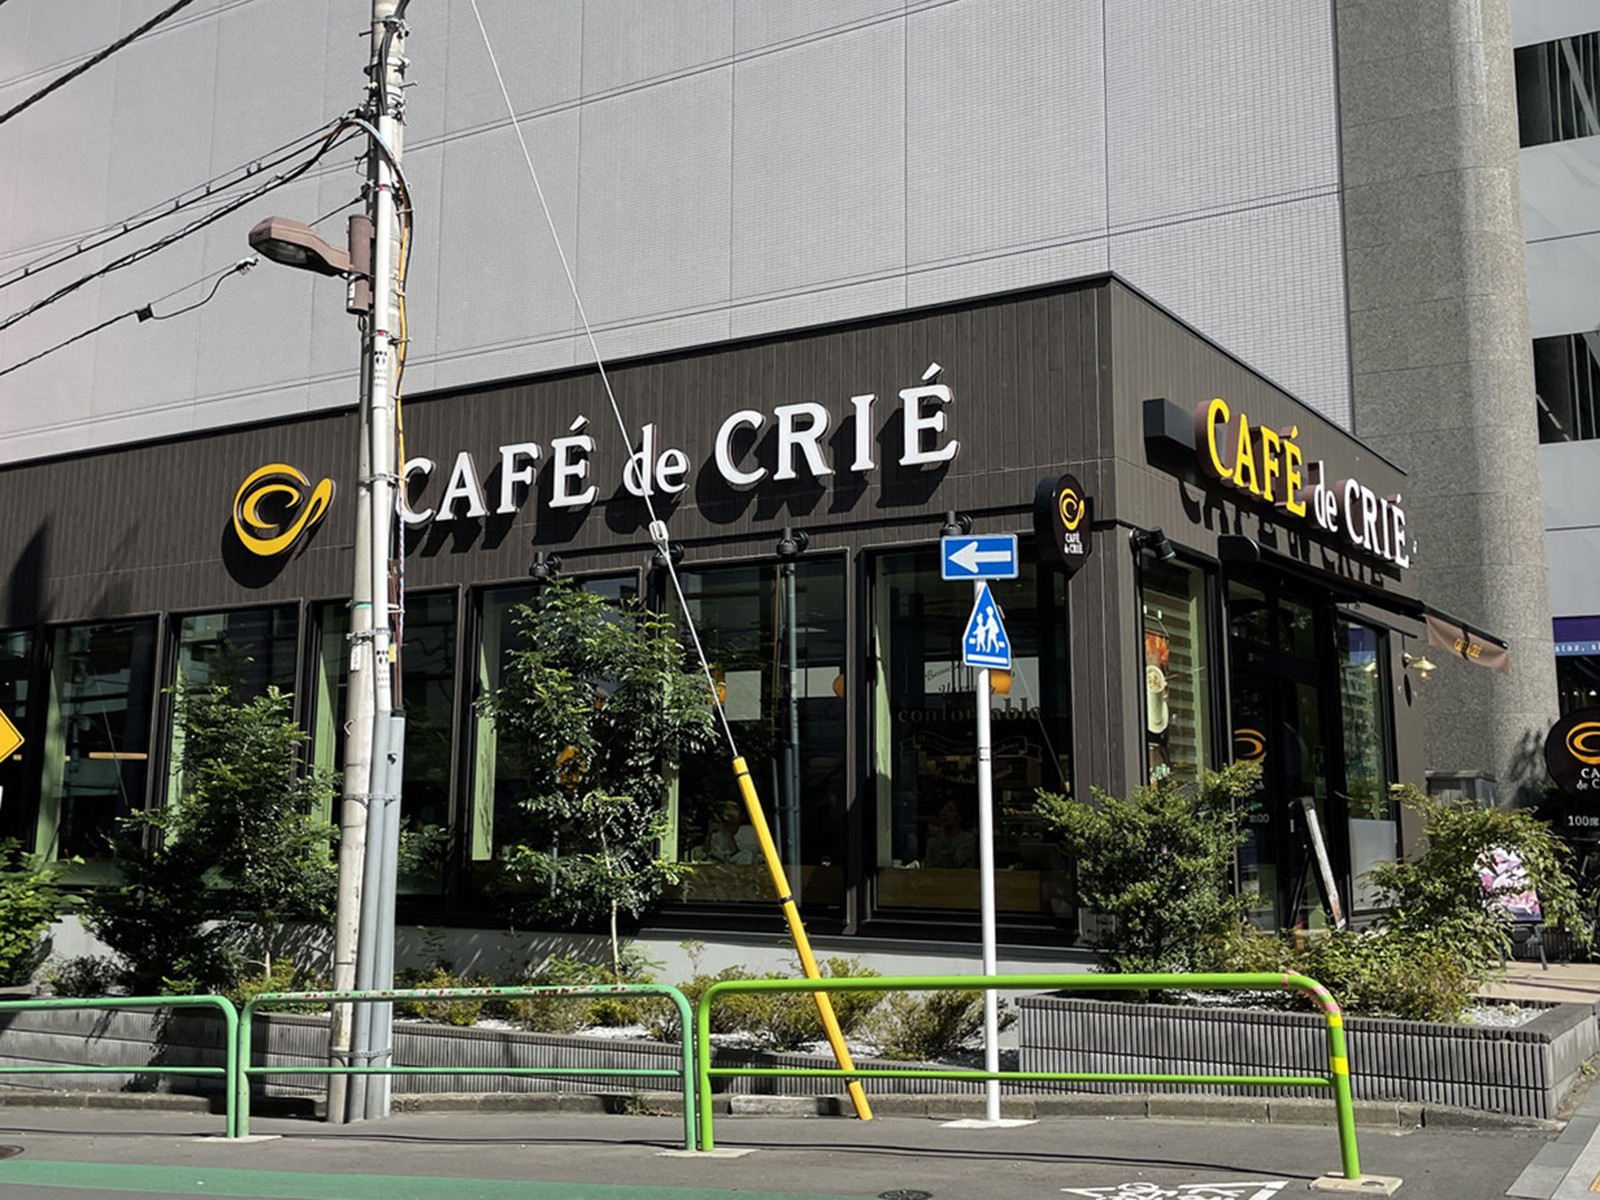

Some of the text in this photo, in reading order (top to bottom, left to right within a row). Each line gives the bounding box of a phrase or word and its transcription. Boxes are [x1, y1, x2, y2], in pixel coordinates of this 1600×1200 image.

[395, 361, 960, 524] CAFÉ de CRIÉ
[1206, 398, 1410, 569] CAFÉ de CRIÉ
